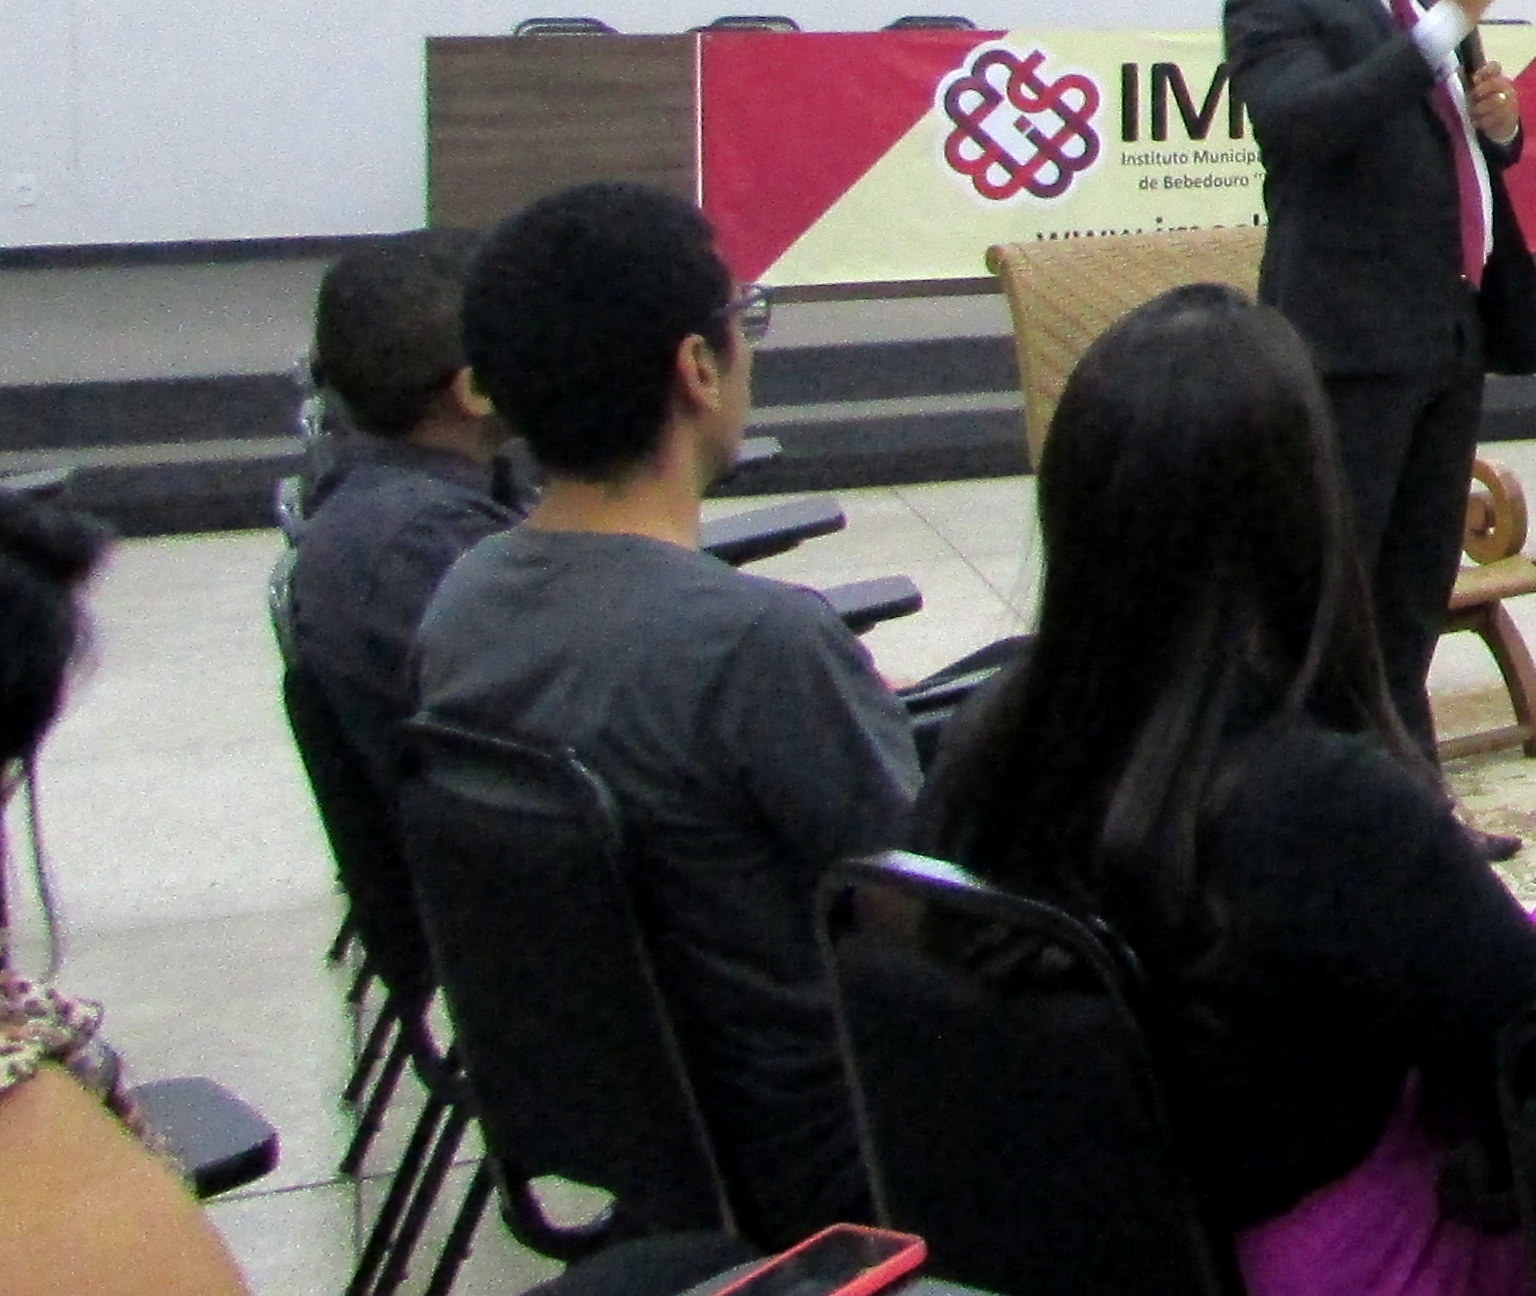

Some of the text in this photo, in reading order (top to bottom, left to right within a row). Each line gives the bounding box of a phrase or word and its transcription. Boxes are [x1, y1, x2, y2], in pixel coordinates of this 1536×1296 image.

[1121, 151, 1189, 166] Instituto
[1139, 175, 1158, 190] de
[1164, 172, 1249, 189] Bebedouro
